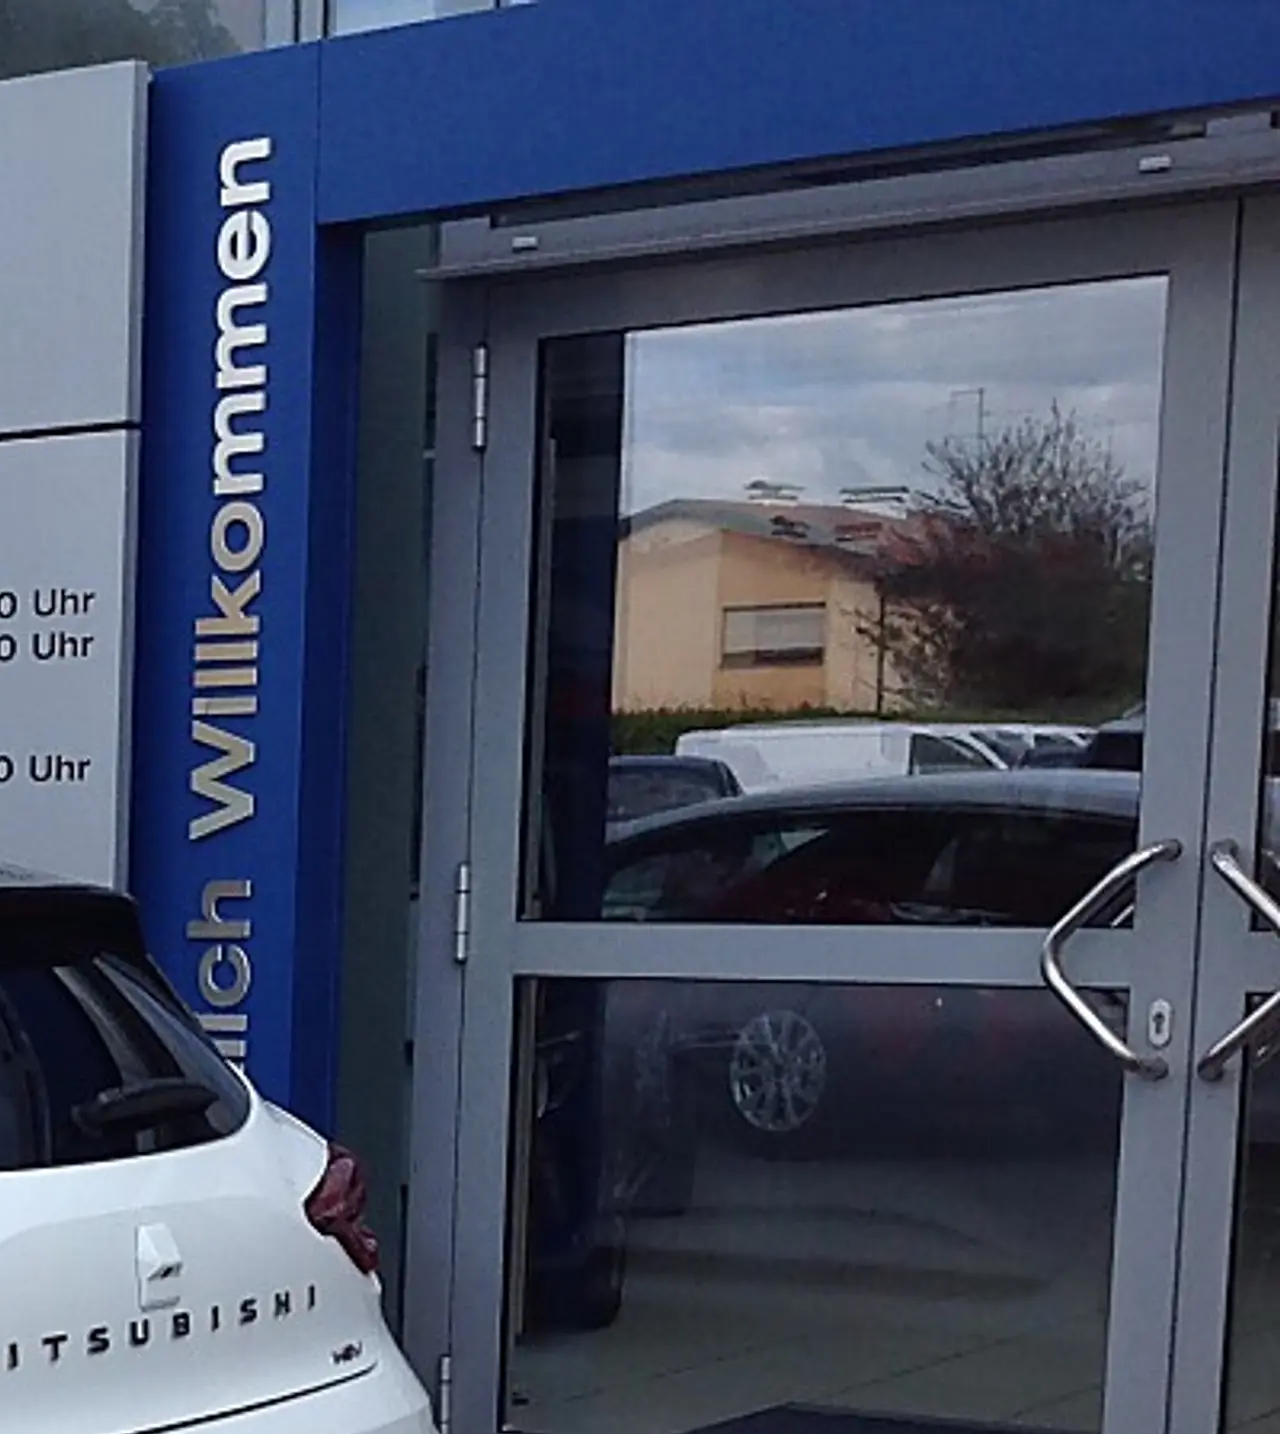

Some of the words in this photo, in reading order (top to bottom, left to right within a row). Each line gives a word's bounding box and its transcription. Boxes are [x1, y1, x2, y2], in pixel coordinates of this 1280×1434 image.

[188, 136, 273, 840] Willkommen
[32, 587, 96, 618] Uhr
[32, 630, 95, 661] Uhr
[29, 753, 92, 782] Uhr
